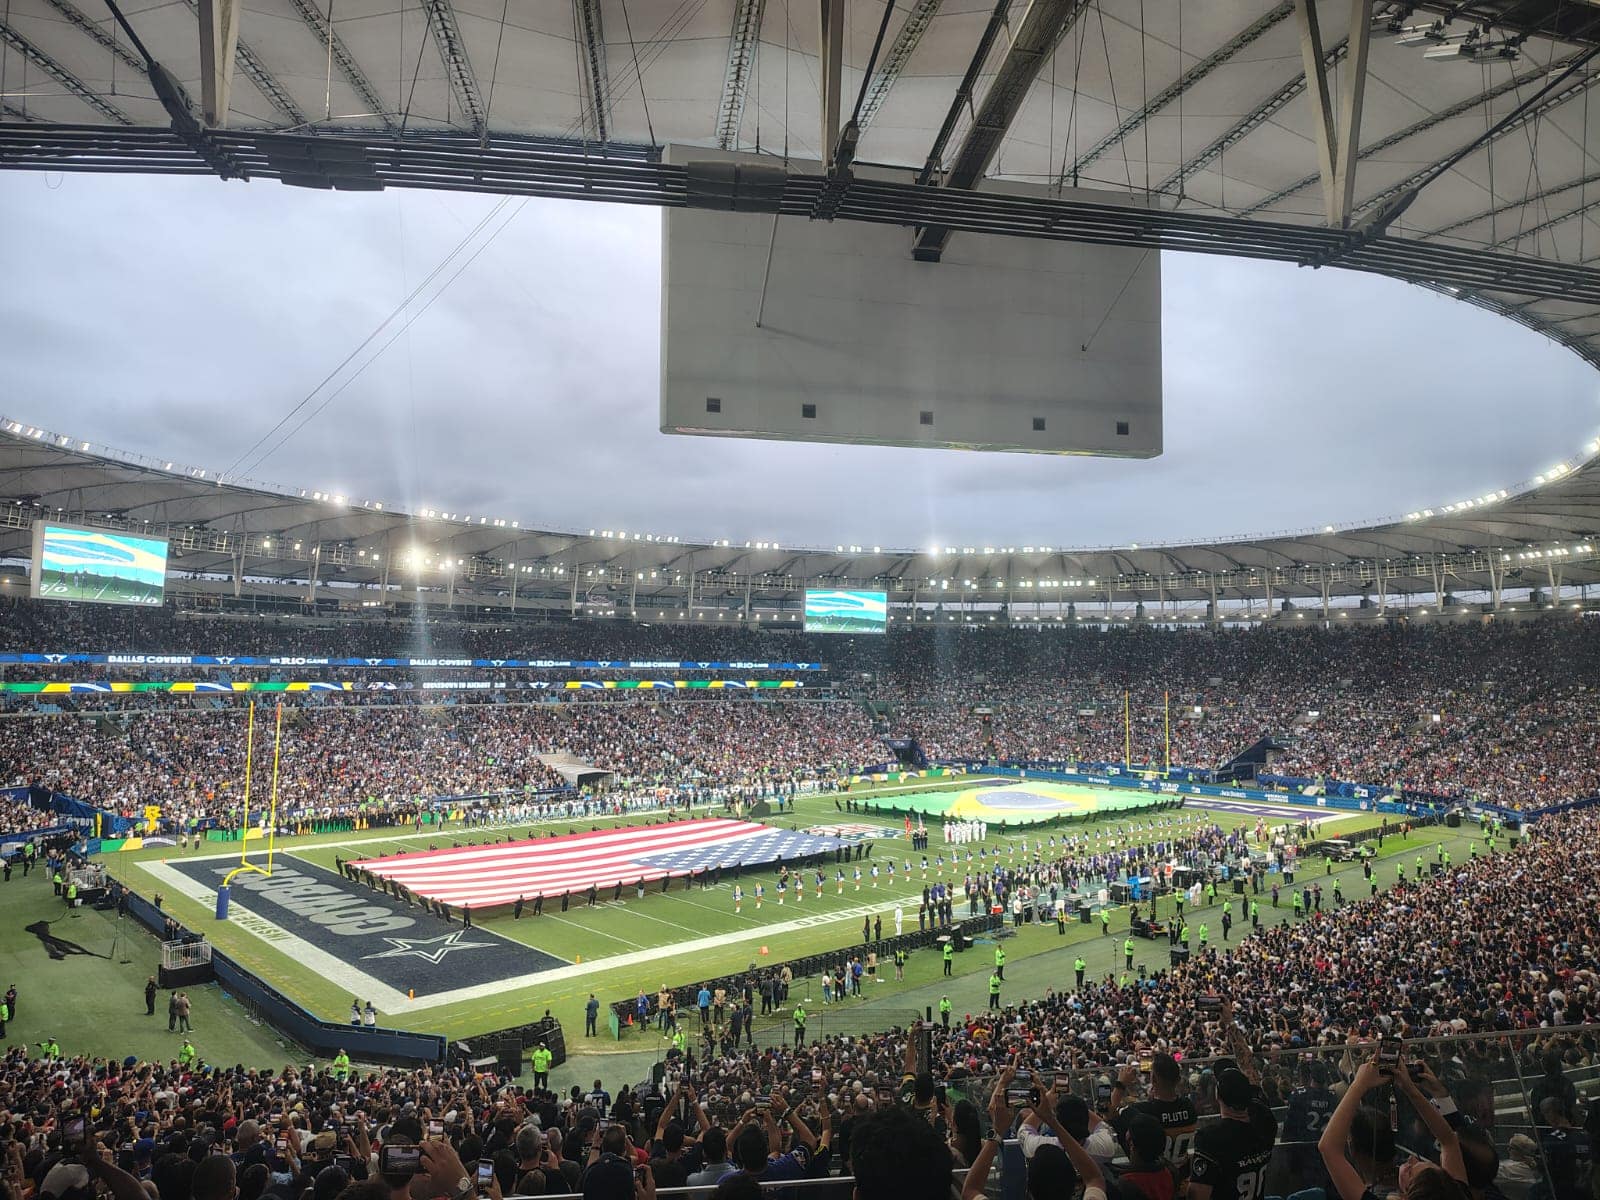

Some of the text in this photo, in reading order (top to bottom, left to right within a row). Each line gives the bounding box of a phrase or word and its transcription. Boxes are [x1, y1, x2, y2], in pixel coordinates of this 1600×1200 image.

[108, 655, 145, 663] DALLAS
[211, 863, 416, 936] COWBOYS
[1161, 1110, 1189, 1123] PLUTO
